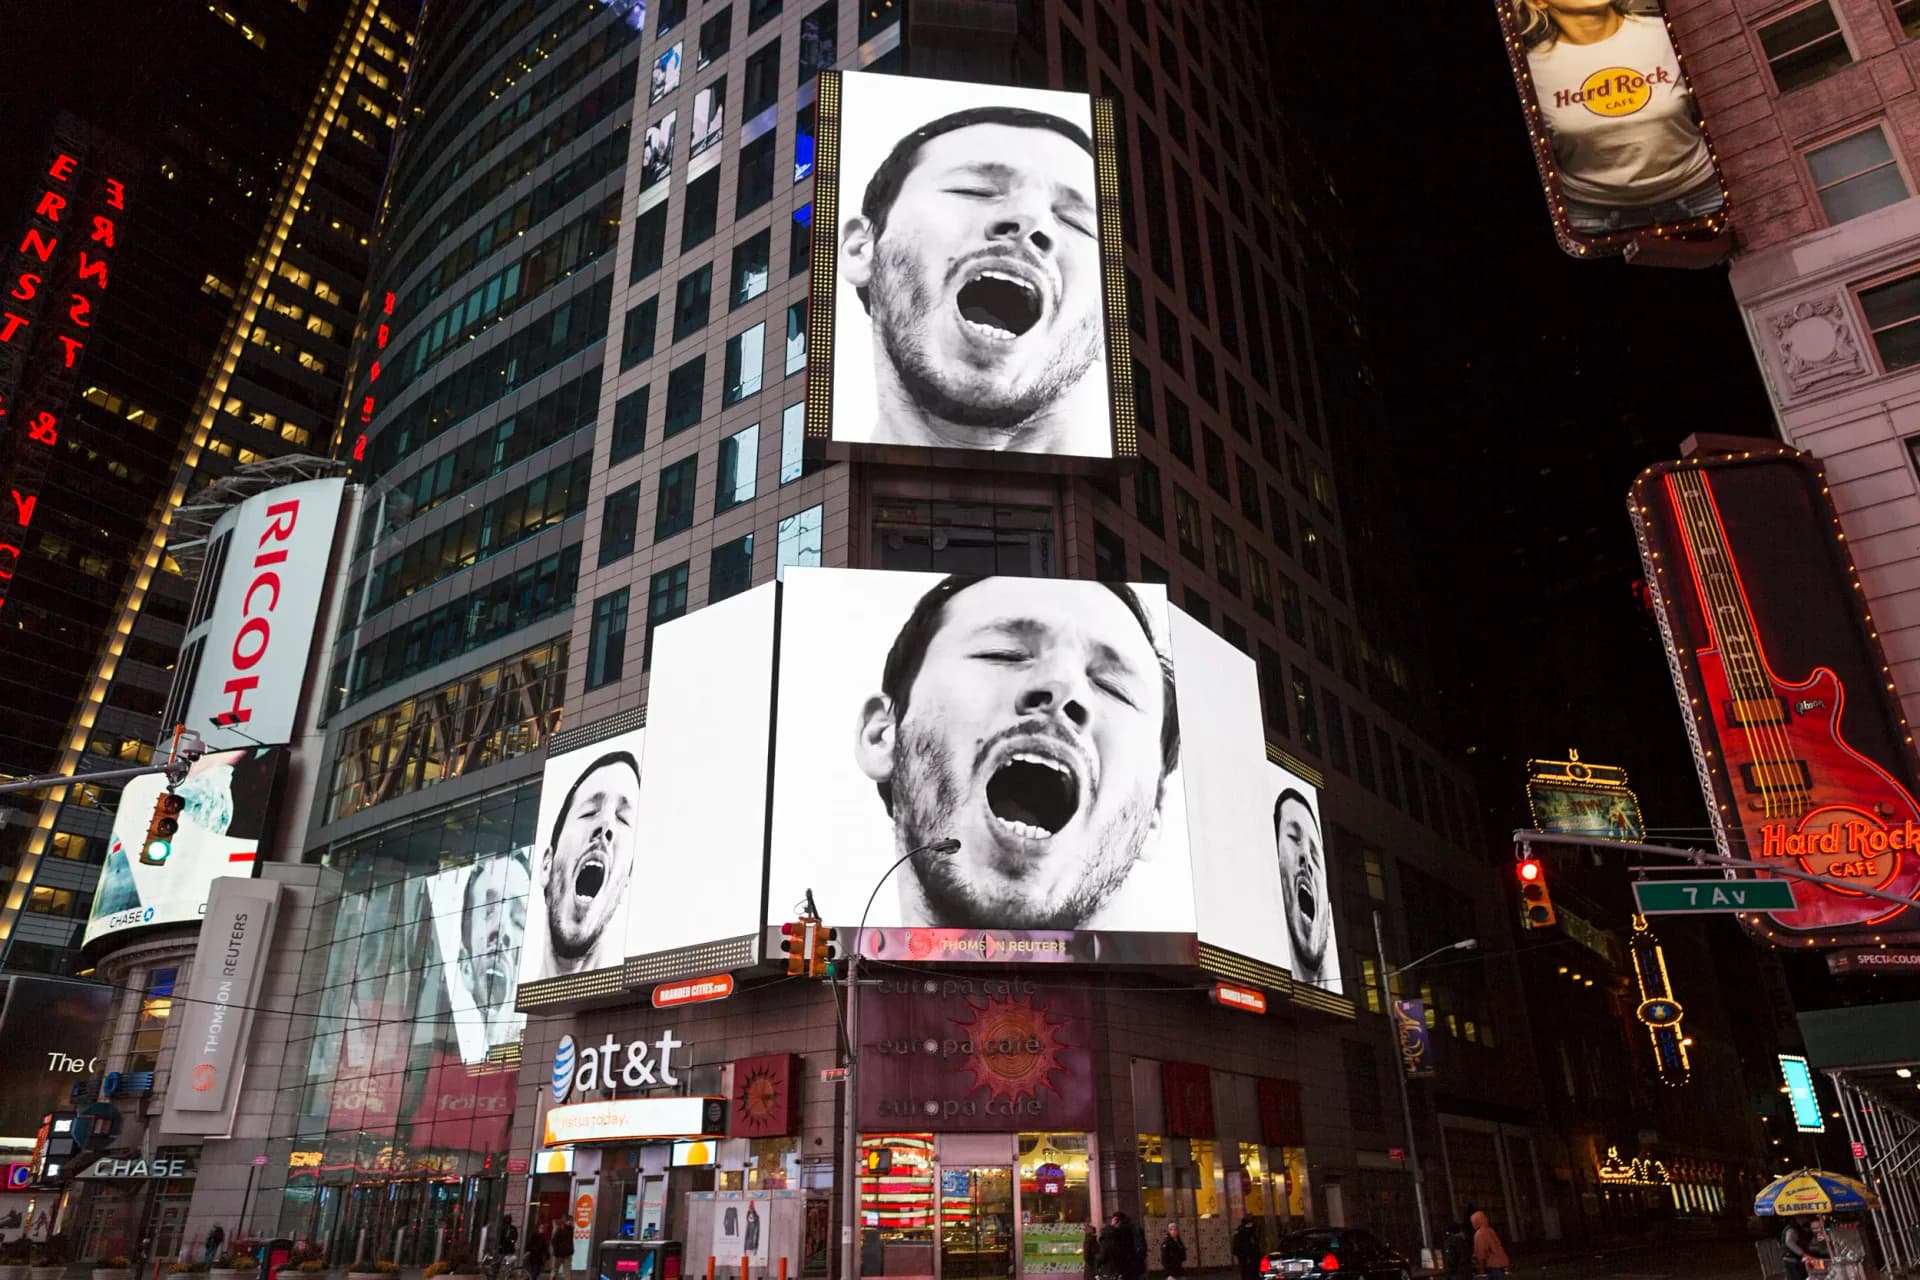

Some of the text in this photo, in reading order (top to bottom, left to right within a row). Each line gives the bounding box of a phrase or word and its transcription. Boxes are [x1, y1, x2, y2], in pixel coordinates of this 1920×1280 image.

[1553, 66, 1672, 108] Hard Rock
[1605, 98, 1635, 110] CAFE
[217, 499, 300, 727] RICOH
[1761, 819, 1920, 858] Hard Rock
[1828, 861, 1878, 877] CAFE
[1682, 887, 1746, 906] 7 Av
[109, 911, 143, 928] CHASE
[1008, 940, 1066, 952] REUTERS
[204, 912, 249, 1055] THOMSON REUTERS
[48, 1053, 85, 1073] The
[576, 1030, 682, 1092] at&t
[94, 1159, 186, 1177] CHASE
